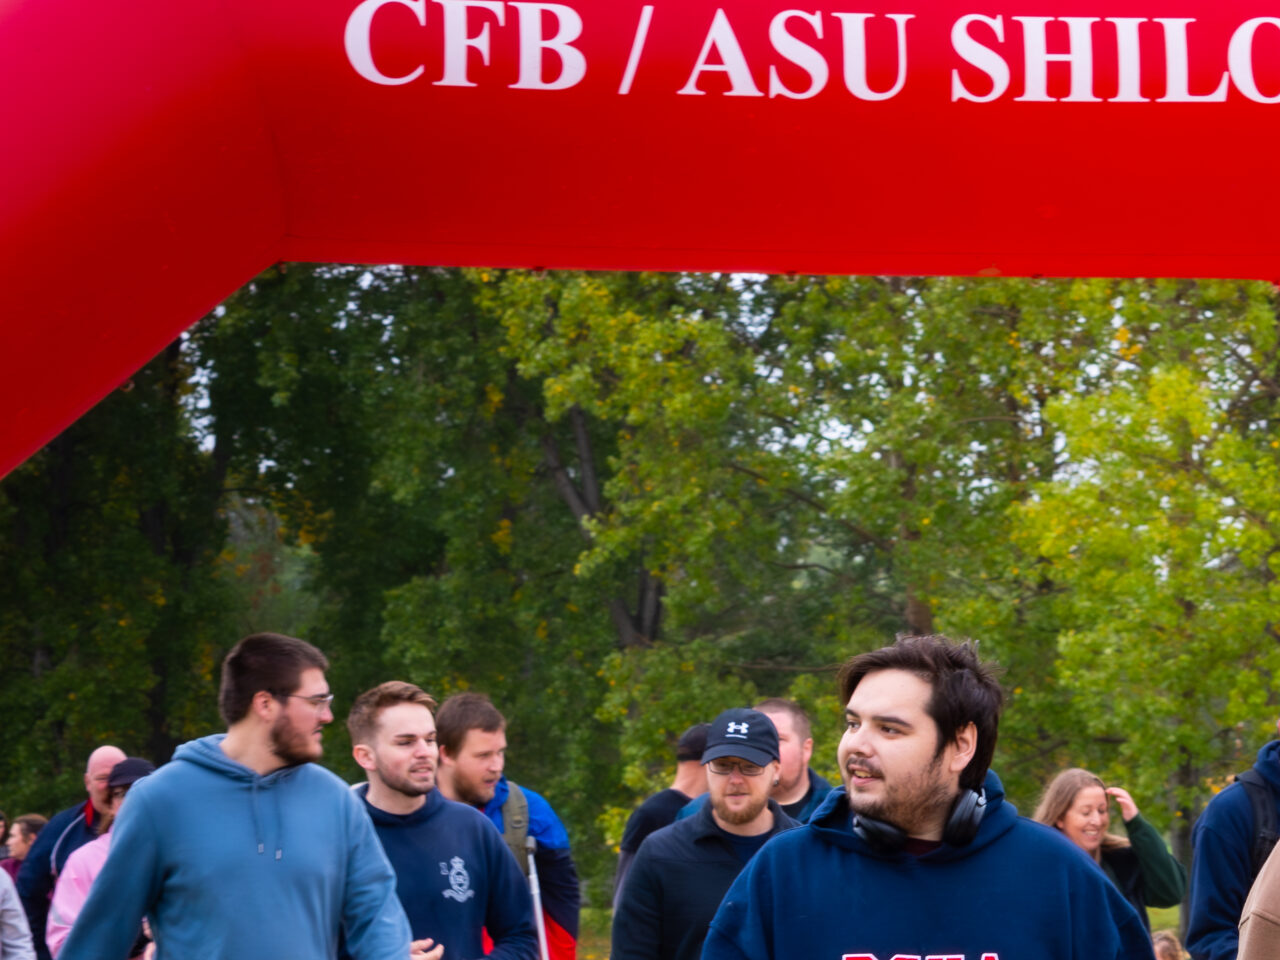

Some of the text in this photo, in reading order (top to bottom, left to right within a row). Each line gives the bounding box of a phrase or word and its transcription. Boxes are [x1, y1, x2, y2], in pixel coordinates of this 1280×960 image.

[344, 0, 588, 90] CFB
[617, 5, 655, 95] /
[676, 8, 916, 100] ASU
